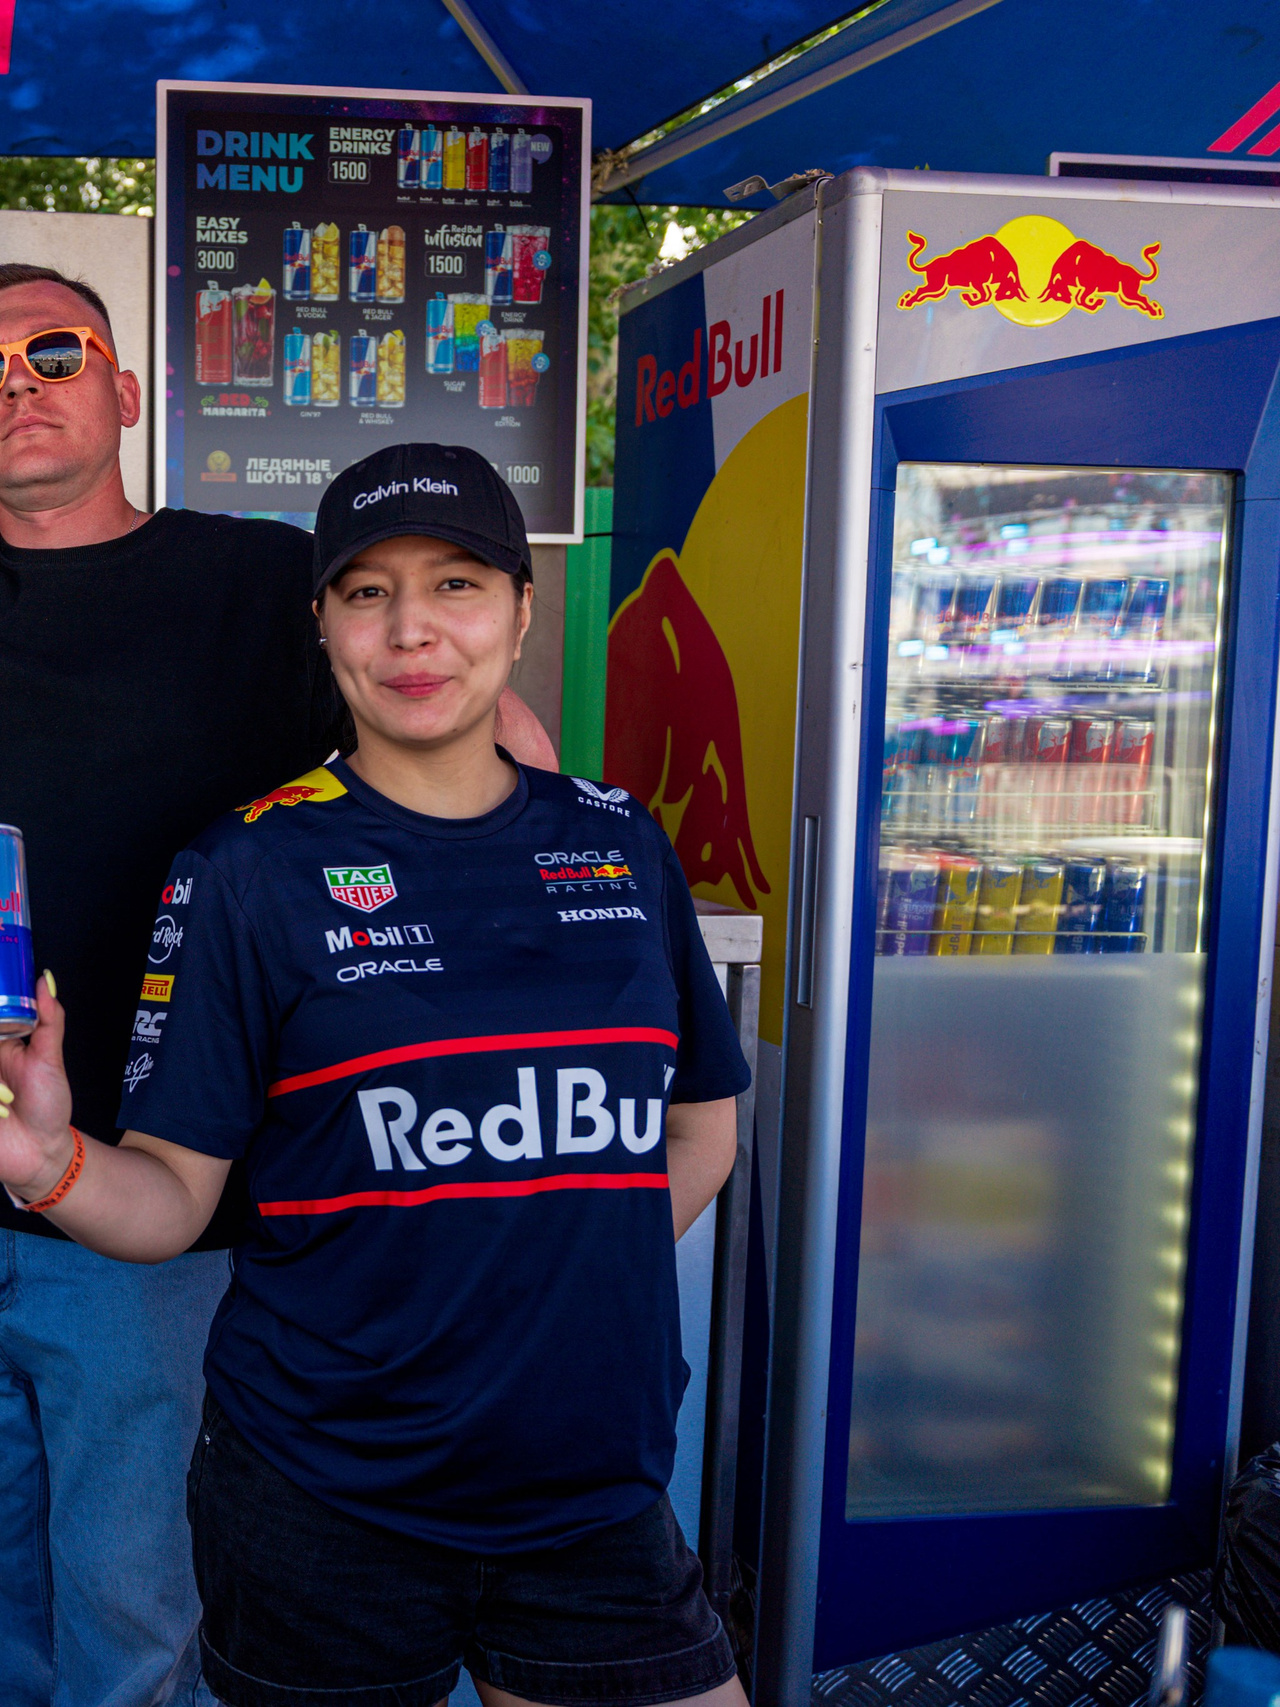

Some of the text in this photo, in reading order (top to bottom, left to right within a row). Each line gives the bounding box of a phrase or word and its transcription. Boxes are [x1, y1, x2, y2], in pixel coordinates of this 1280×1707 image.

[329, 127, 396, 142] ENERGY
[196, 129, 315, 160] DRINK
[329, 141, 392, 155] DRINKS
[530, 142, 550, 152] NEW
[196, 163, 304, 193] MENU
[332, 161, 367, 180] 1500
[196, 216, 241, 230] EASY
[451, 224, 483, 233] Red Bull
[196, 230, 249, 244] MIXES
[424, 224, 483, 249] infusion
[197, 250, 235, 270] 3000
[428, 255, 463, 274] 1500
[635, 288, 784, 428] Red Bull
[219, 393, 251, 406] RED
[202, 407, 267, 417] MARGARITA
[246, 458, 331, 472] ЛЕДЯНЫЕ
[246, 471, 301, 484] ШОТЫ
[305, 472, 322, 485] 18
[506, 465, 540, 484] 1000
[353, 477, 459, 510] Calvin Klein
[578, 796, 631, 818] CASTORE
[534, 850, 624, 866] ORACLE
[330, 869, 386, 885] TAG
[539, 866, 592, 880] Red Bull
[162, 877, 193, 904] obil
[546, 881, 637, 894] RACING
[333, 886, 392, 909] HEUER
[557, 906, 648, 922] HONDA
[161, 926, 183, 947] Rock
[325, 926, 405, 954] Mobil
[894, 939, 906, 956] ed
[336, 958, 444, 982] ORACLE
[142, 985, 168, 996] RELLI
[133, 1009, 167, 1036] RC
[357, 1065, 668, 1171] Red Bu
